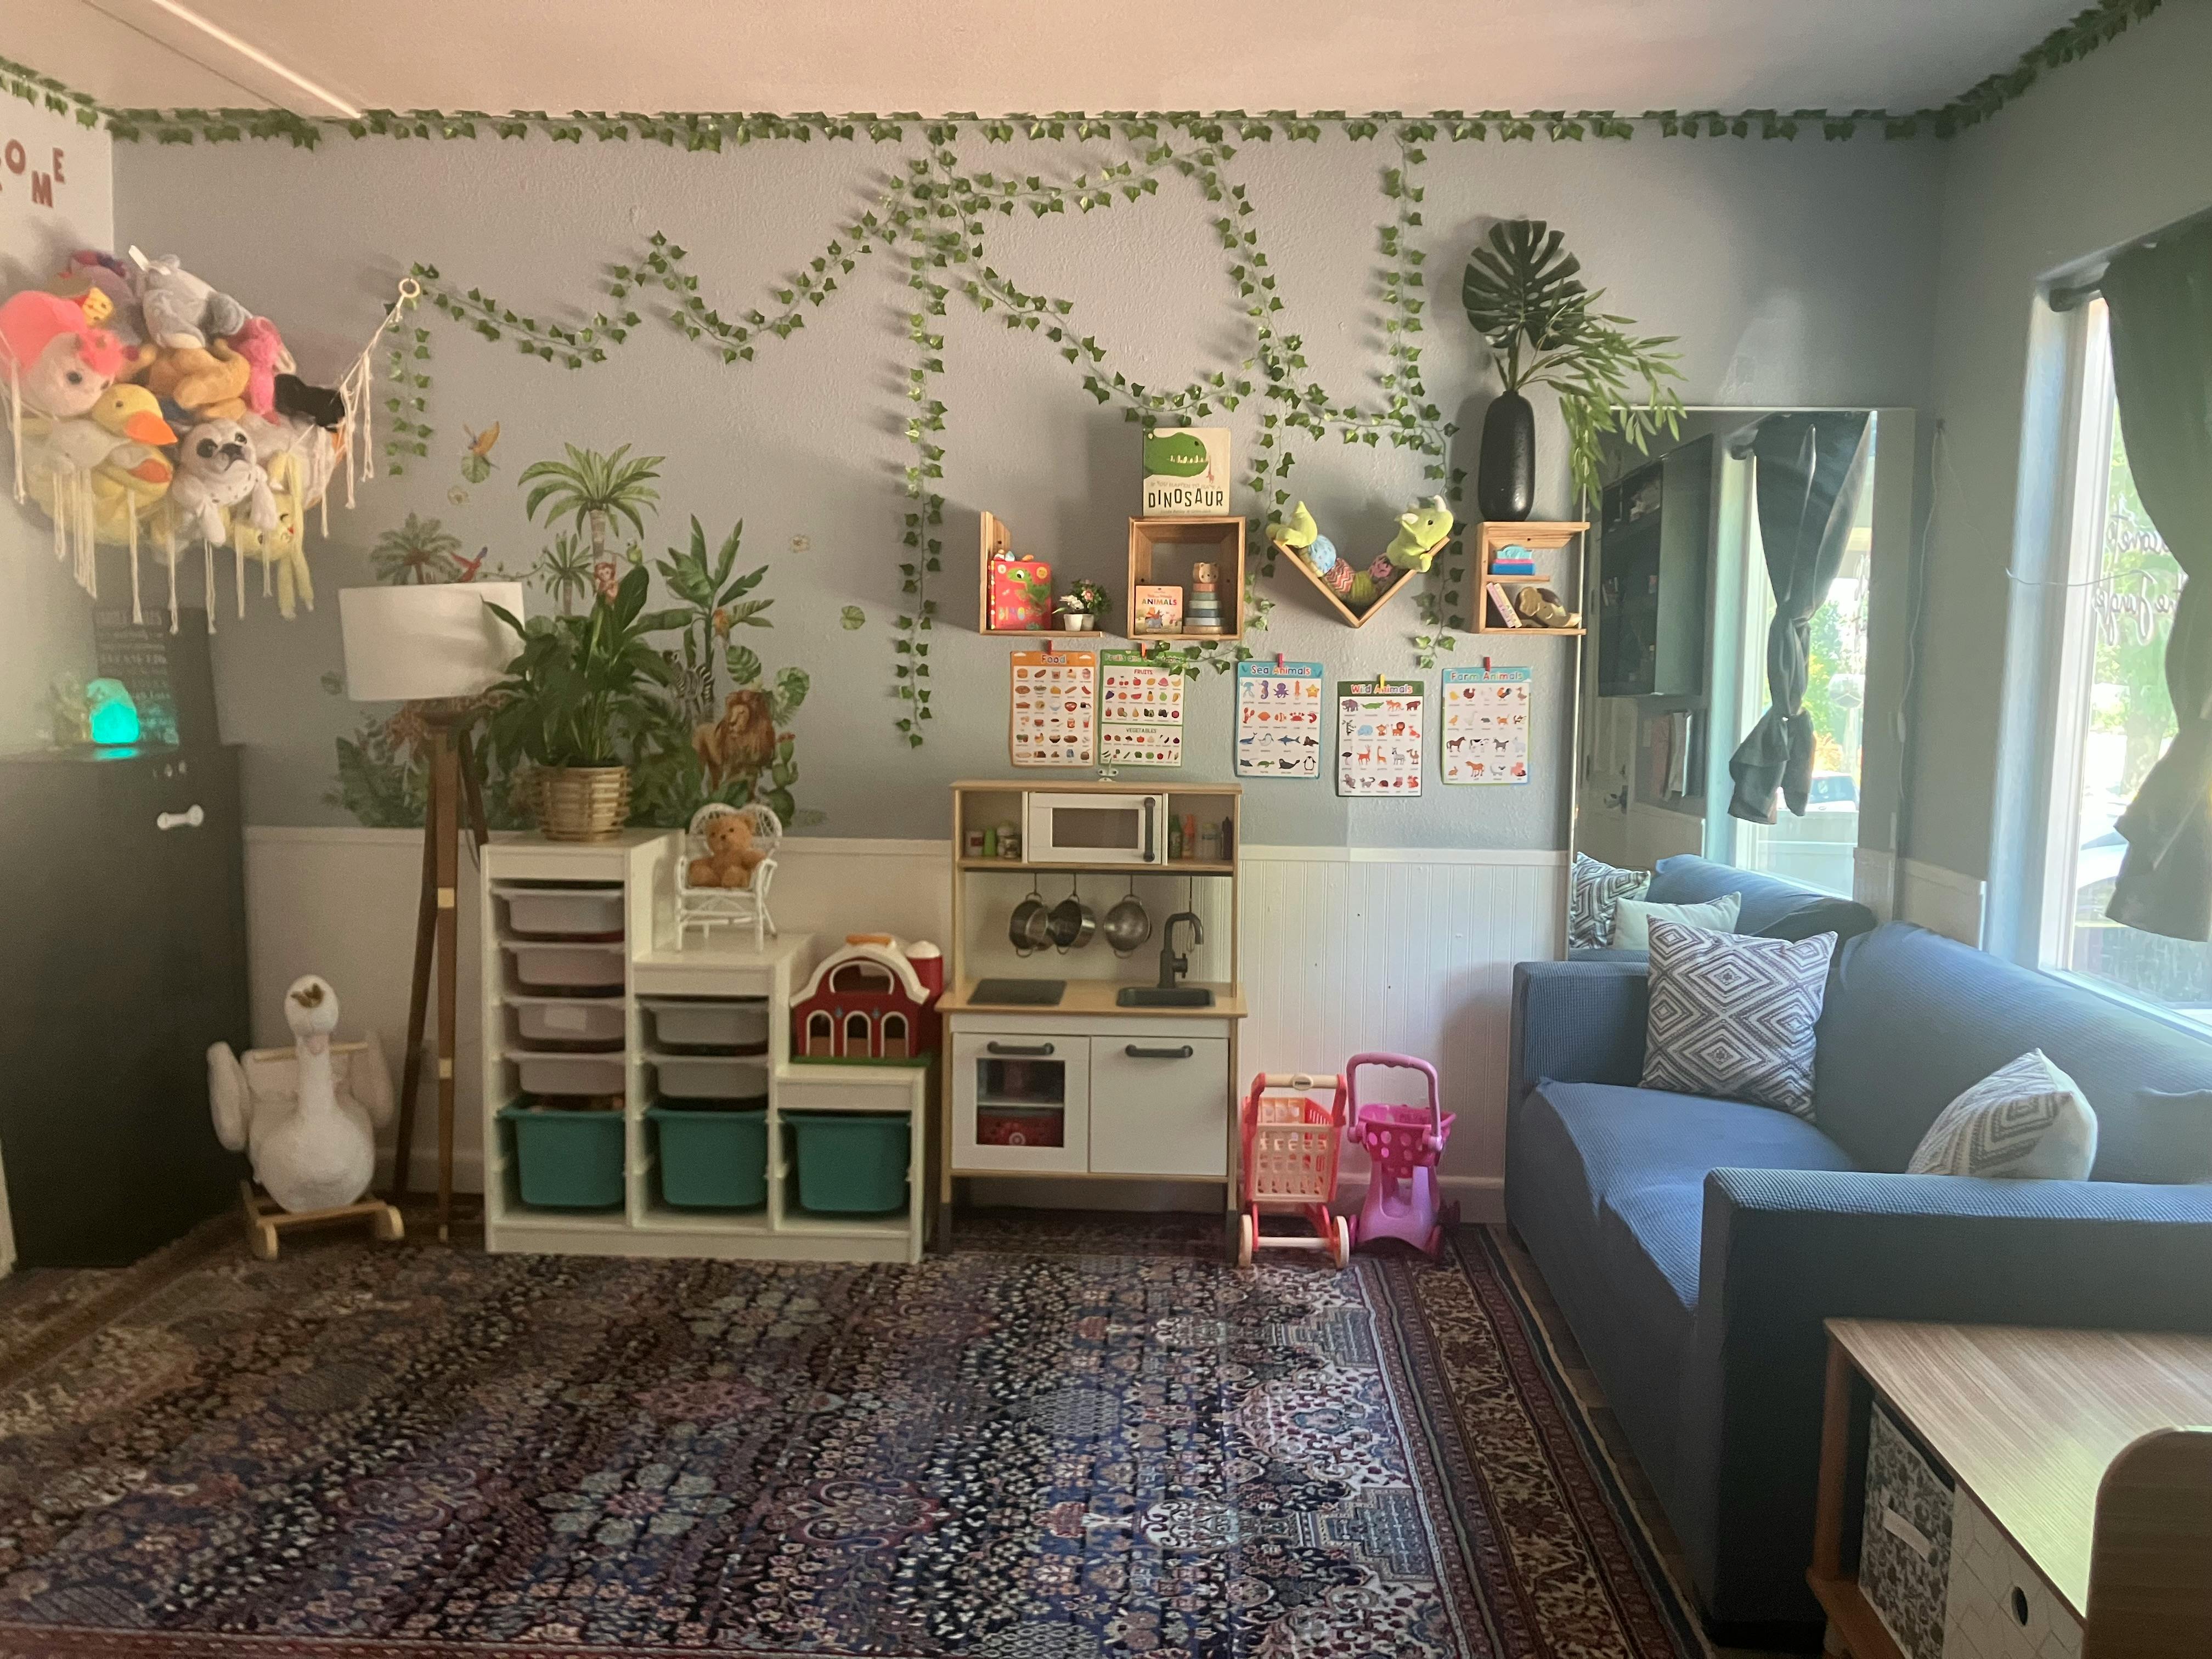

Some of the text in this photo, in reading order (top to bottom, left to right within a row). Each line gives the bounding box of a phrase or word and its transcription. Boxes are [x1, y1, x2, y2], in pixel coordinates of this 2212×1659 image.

[0, 139, 65, 208] OME
[1148, 488, 1223, 508] DINOSAUR
[998, 607, 1025, 620] DINO
[1041, 654, 1066, 664] Food
[1105, 653, 1126, 662] Fruits
[1251, 665, 1311, 675] Sea Animals
[1451, 670, 1524, 681] Farm Animals
[1351, 684, 1413, 694] Wild Animals
